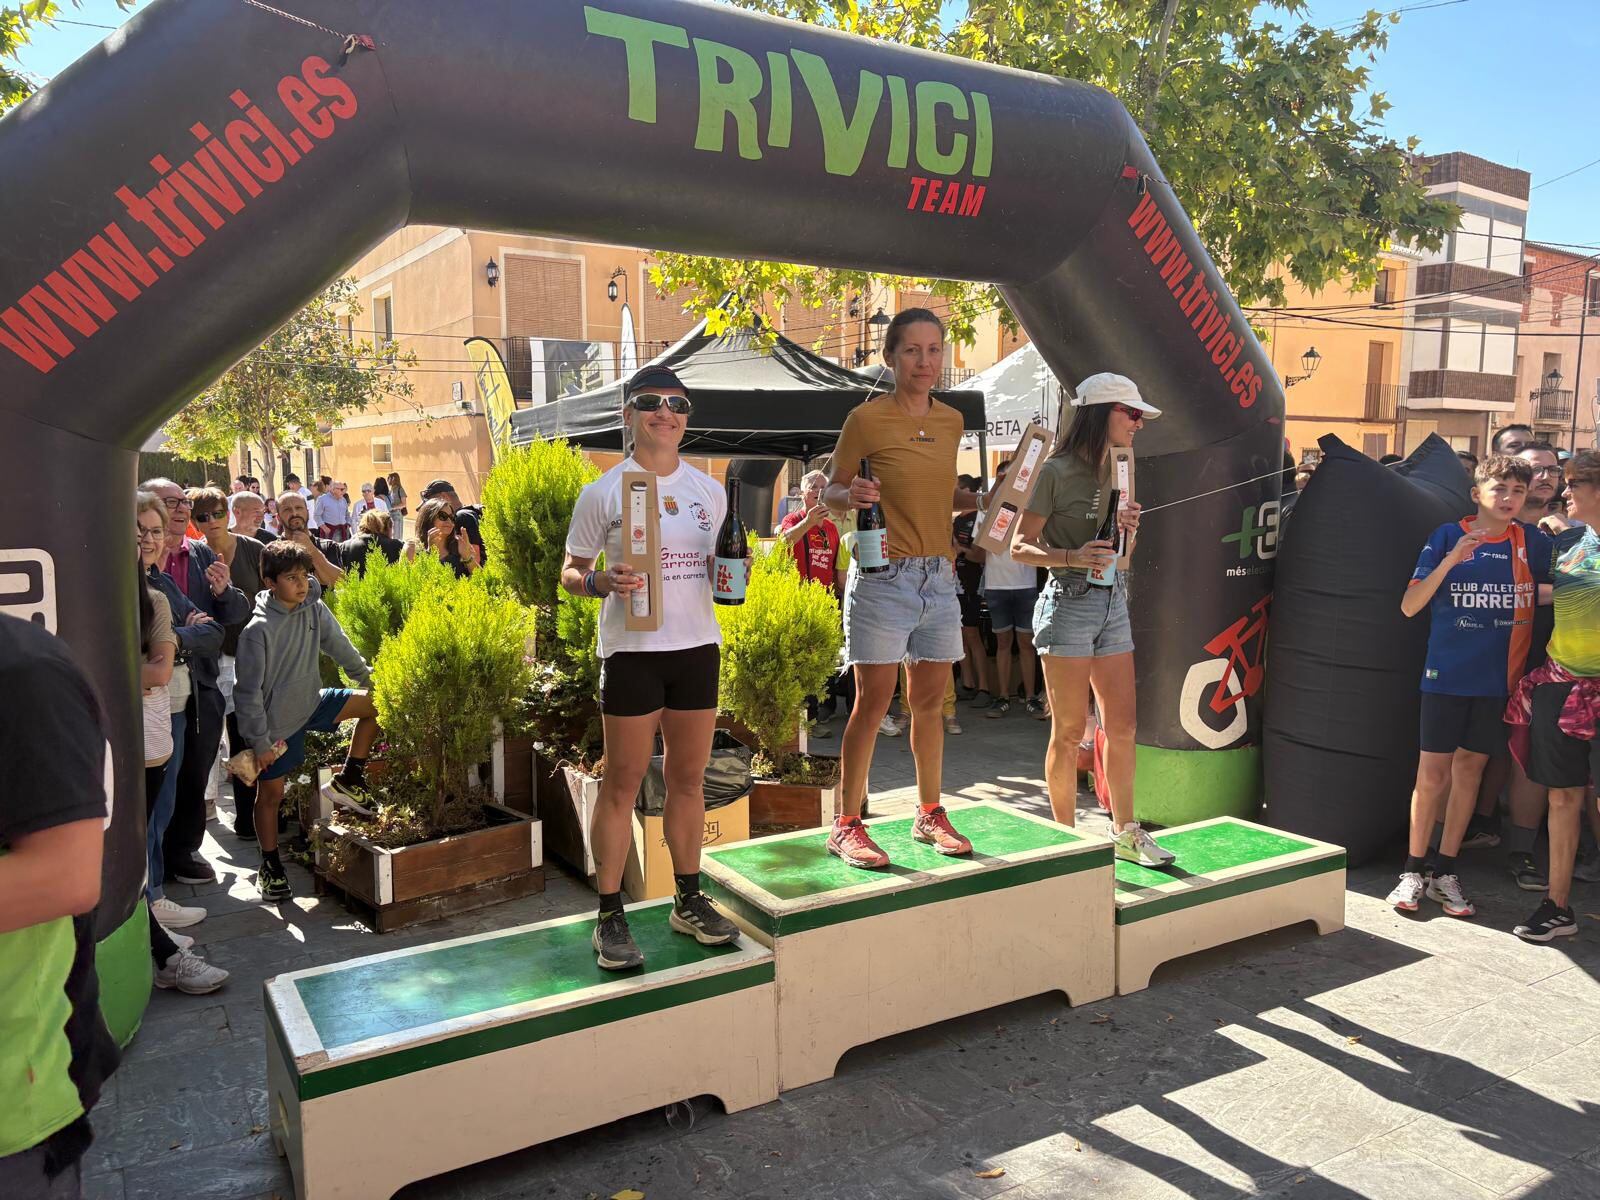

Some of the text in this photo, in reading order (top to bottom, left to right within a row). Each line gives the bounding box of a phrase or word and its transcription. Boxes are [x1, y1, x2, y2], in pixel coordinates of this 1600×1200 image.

[584, 5, 993, 178] TRIVICI
[0, 55, 357, 374] www.trivici.es
[907, 177, 986, 217] TEAM
[1128, 192, 1262, 408] www.trivici.es
[661, 547, 700, 560] Gruas
[1450, 582, 1478, 592] CLUB
[1451, 592, 1534, 608] TORRENT
